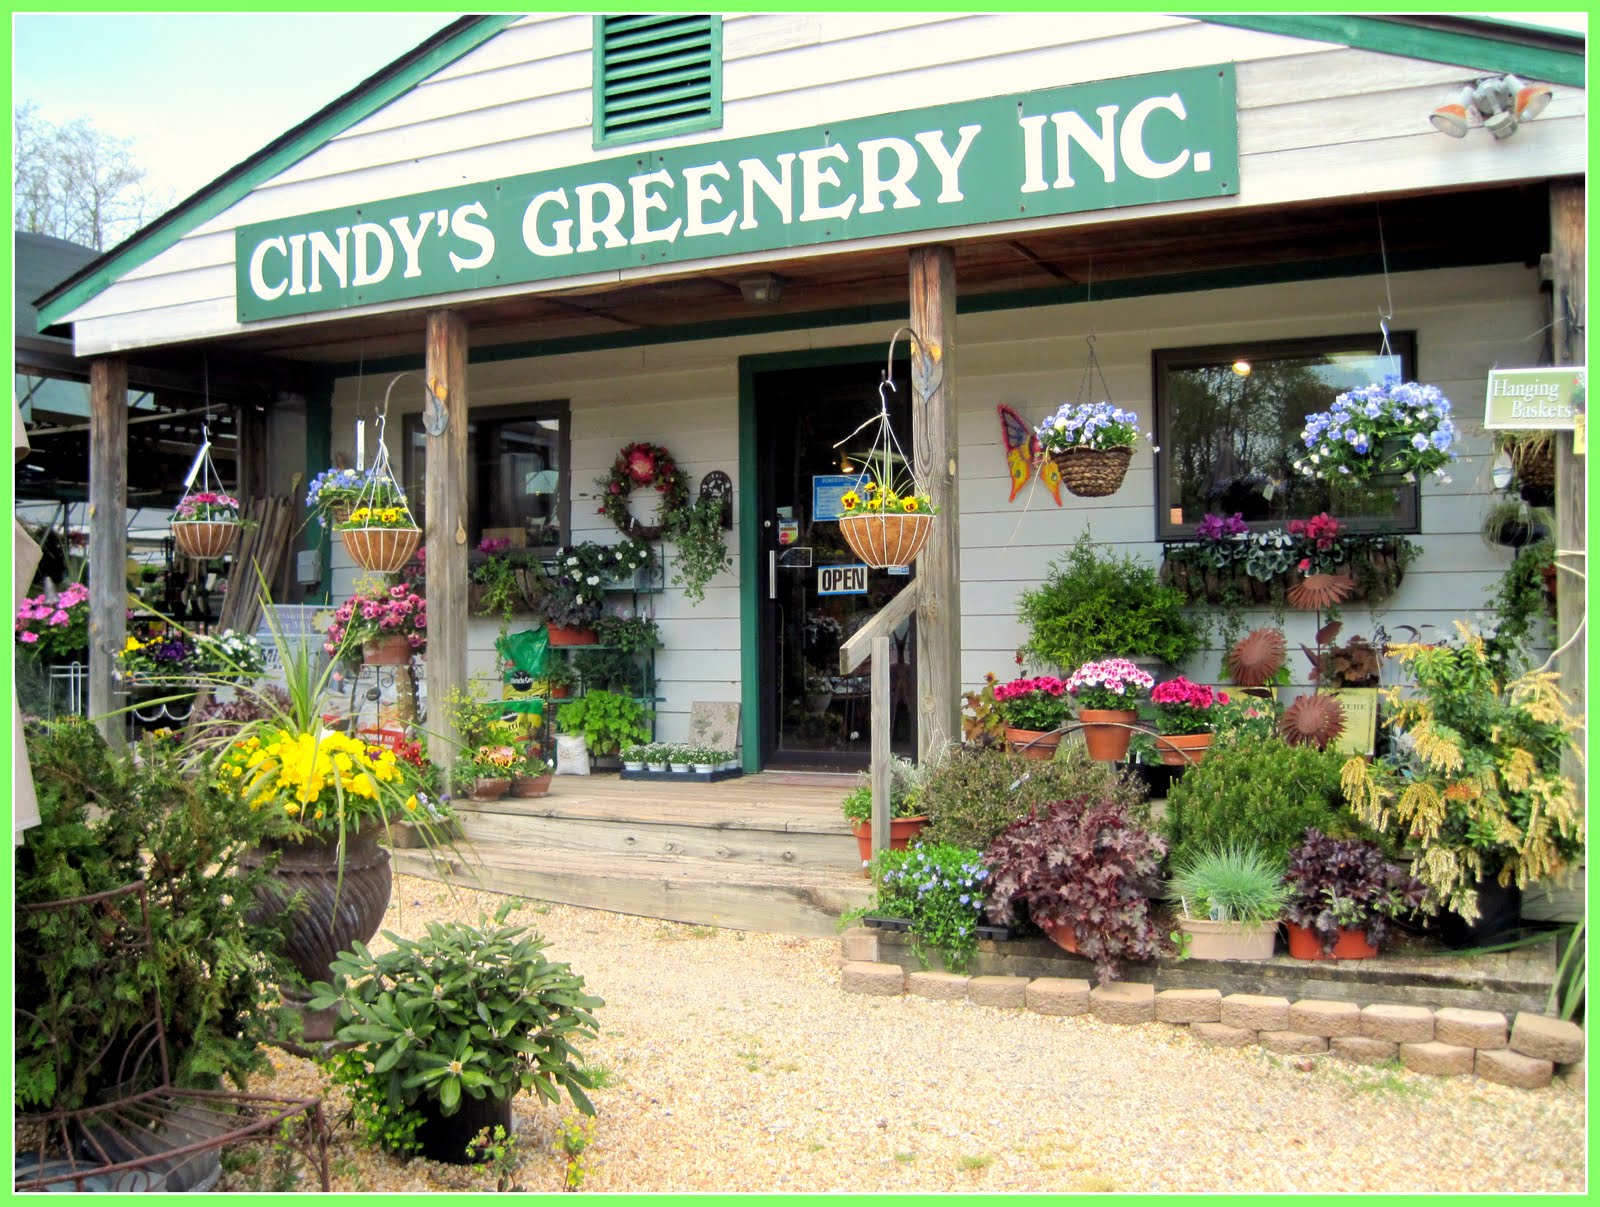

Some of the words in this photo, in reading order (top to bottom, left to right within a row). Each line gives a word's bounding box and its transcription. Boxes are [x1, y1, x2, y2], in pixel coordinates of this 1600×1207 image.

[249, 201, 496, 301] CINDY'S
[522, 124, 982, 257] GREENERY
[1019, 92, 1212, 194] INC.
[1492, 379, 1560, 402] Hanging
[1511, 400, 1572, 418] Baskets
[822, 568, 865, 592] OPEN
